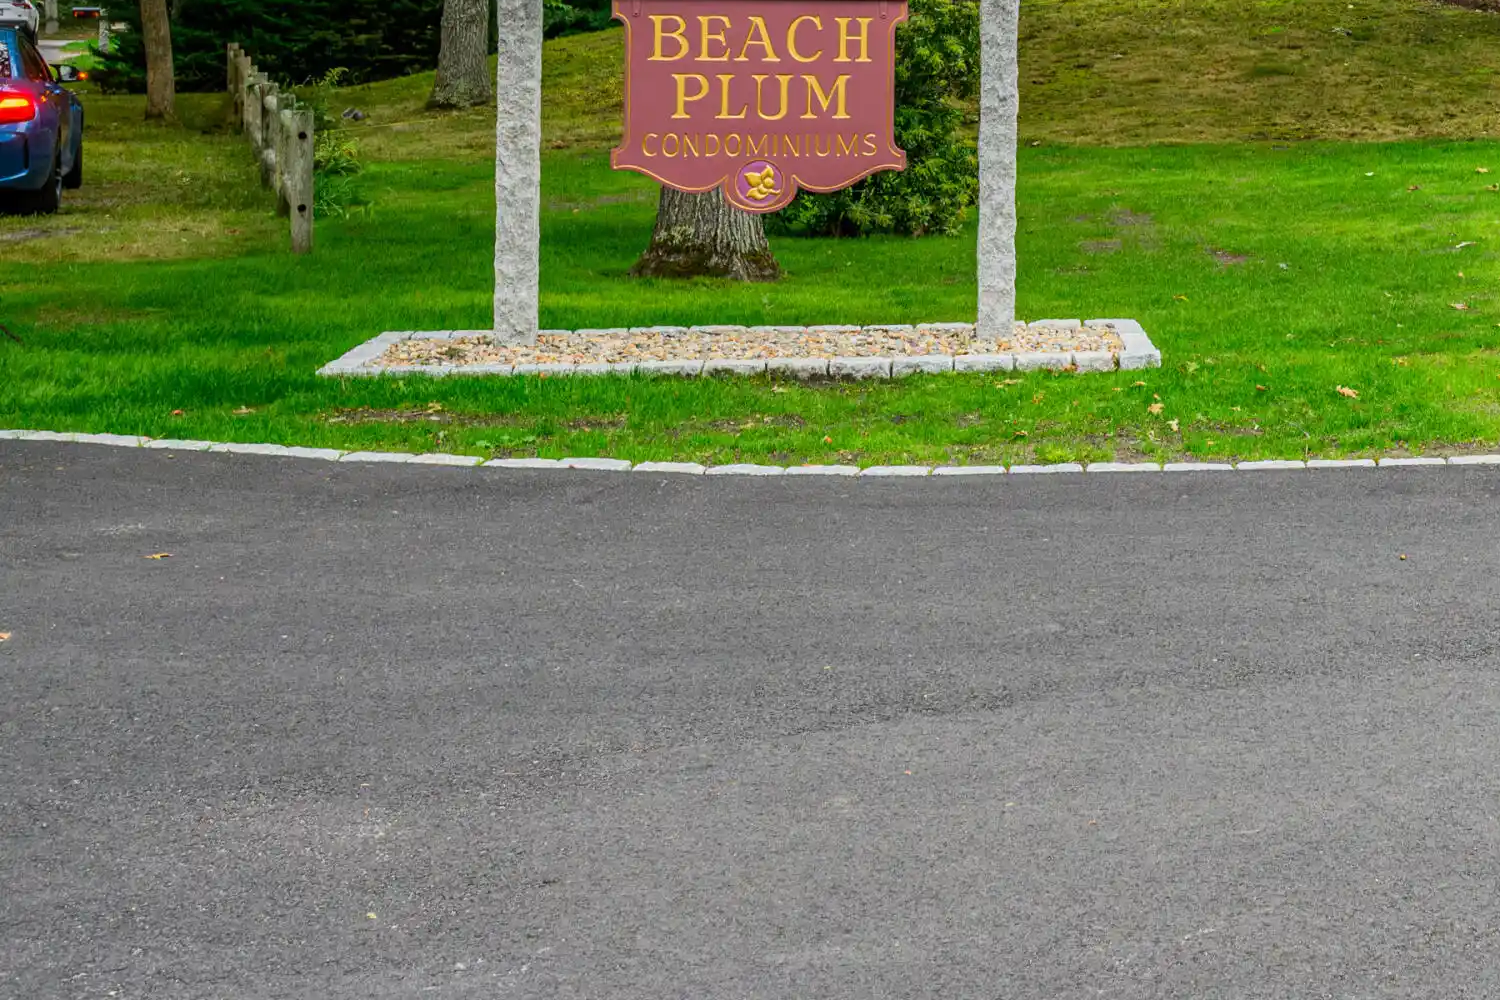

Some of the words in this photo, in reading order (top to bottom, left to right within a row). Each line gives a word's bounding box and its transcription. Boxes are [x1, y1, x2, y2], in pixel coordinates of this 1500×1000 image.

[647, 14, 874, 63] BEACH
[670, 73, 852, 121] PLUM
[642, 132, 878, 158] CONDOMINIUMS
